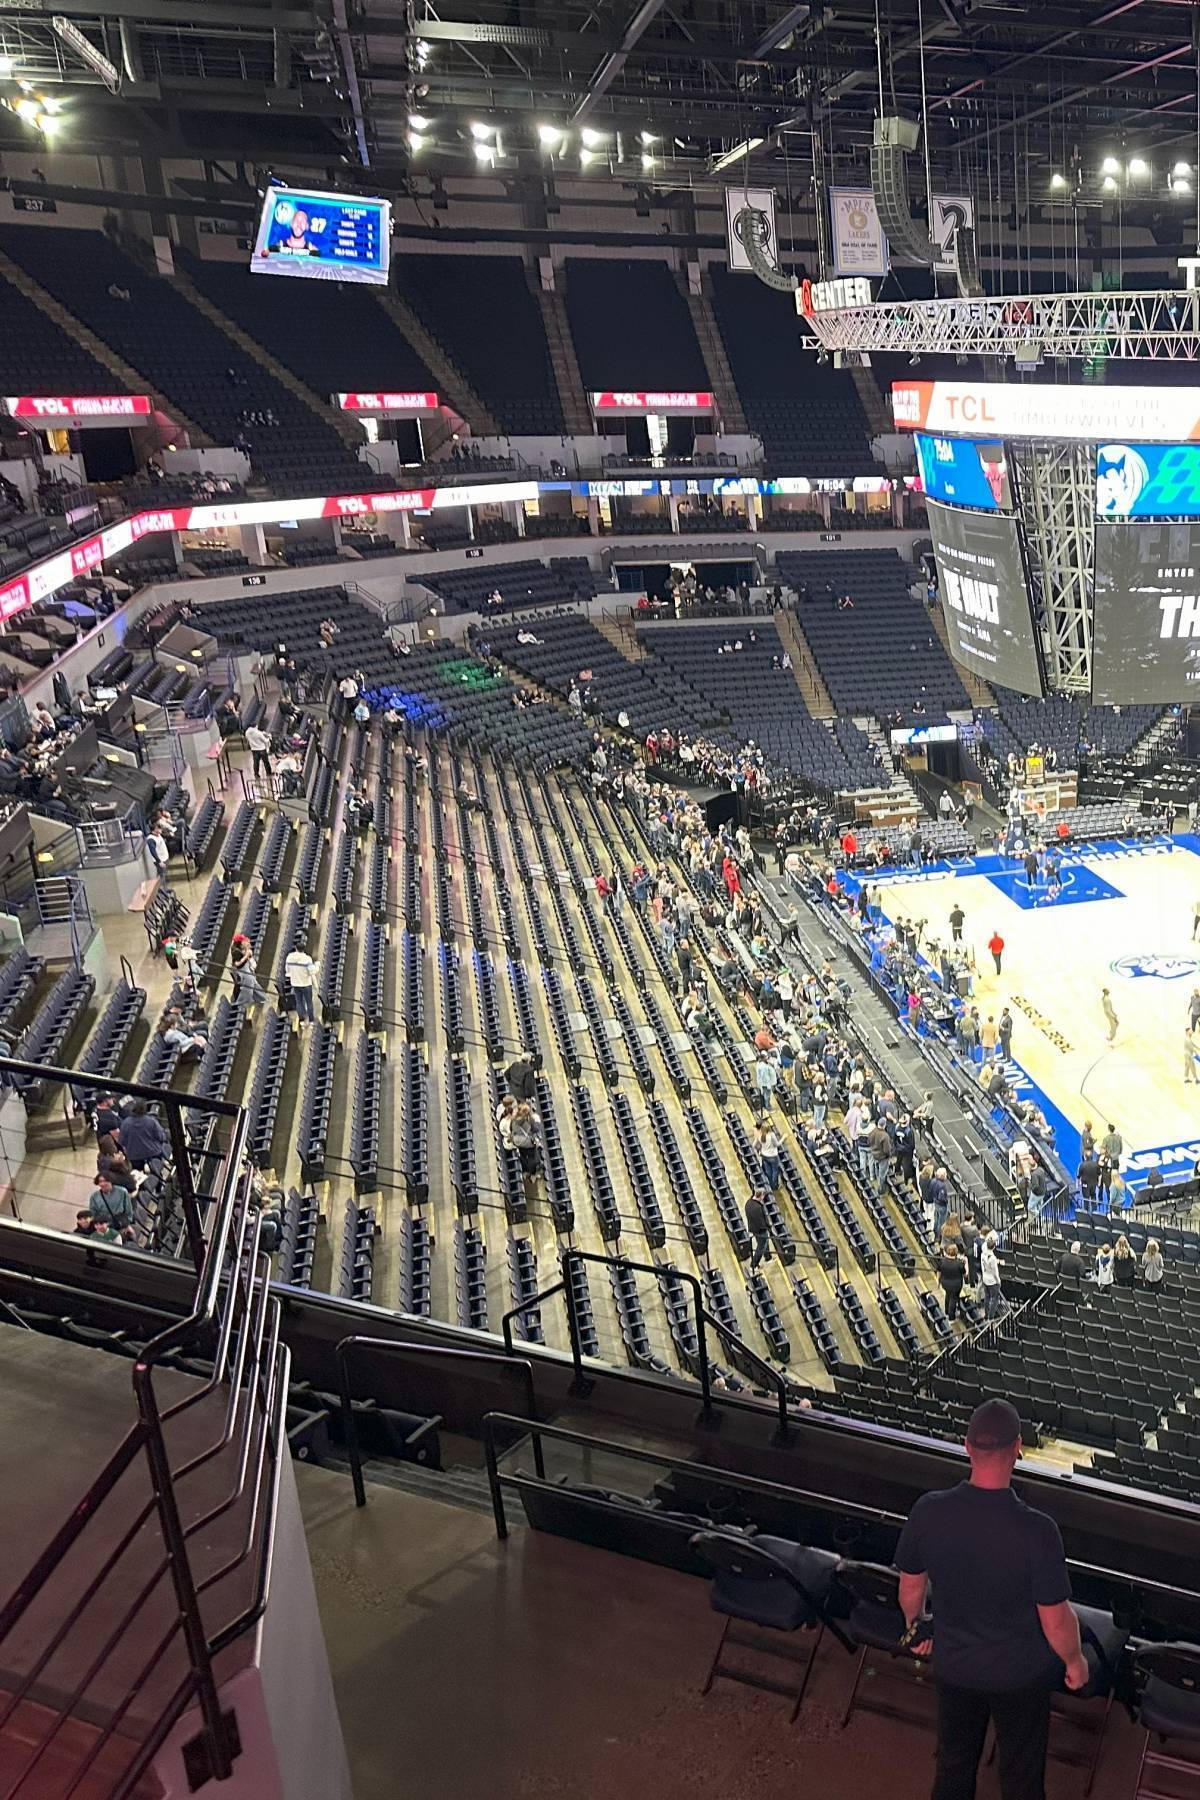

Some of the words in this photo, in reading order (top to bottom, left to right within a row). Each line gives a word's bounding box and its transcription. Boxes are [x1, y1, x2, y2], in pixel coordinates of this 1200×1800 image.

[811, 277, 872, 313] CENTER
[946, 396, 995, 422] TCL
[338, 498, 368, 513] TCL
[1157, 567, 1195, 578] ENTER
